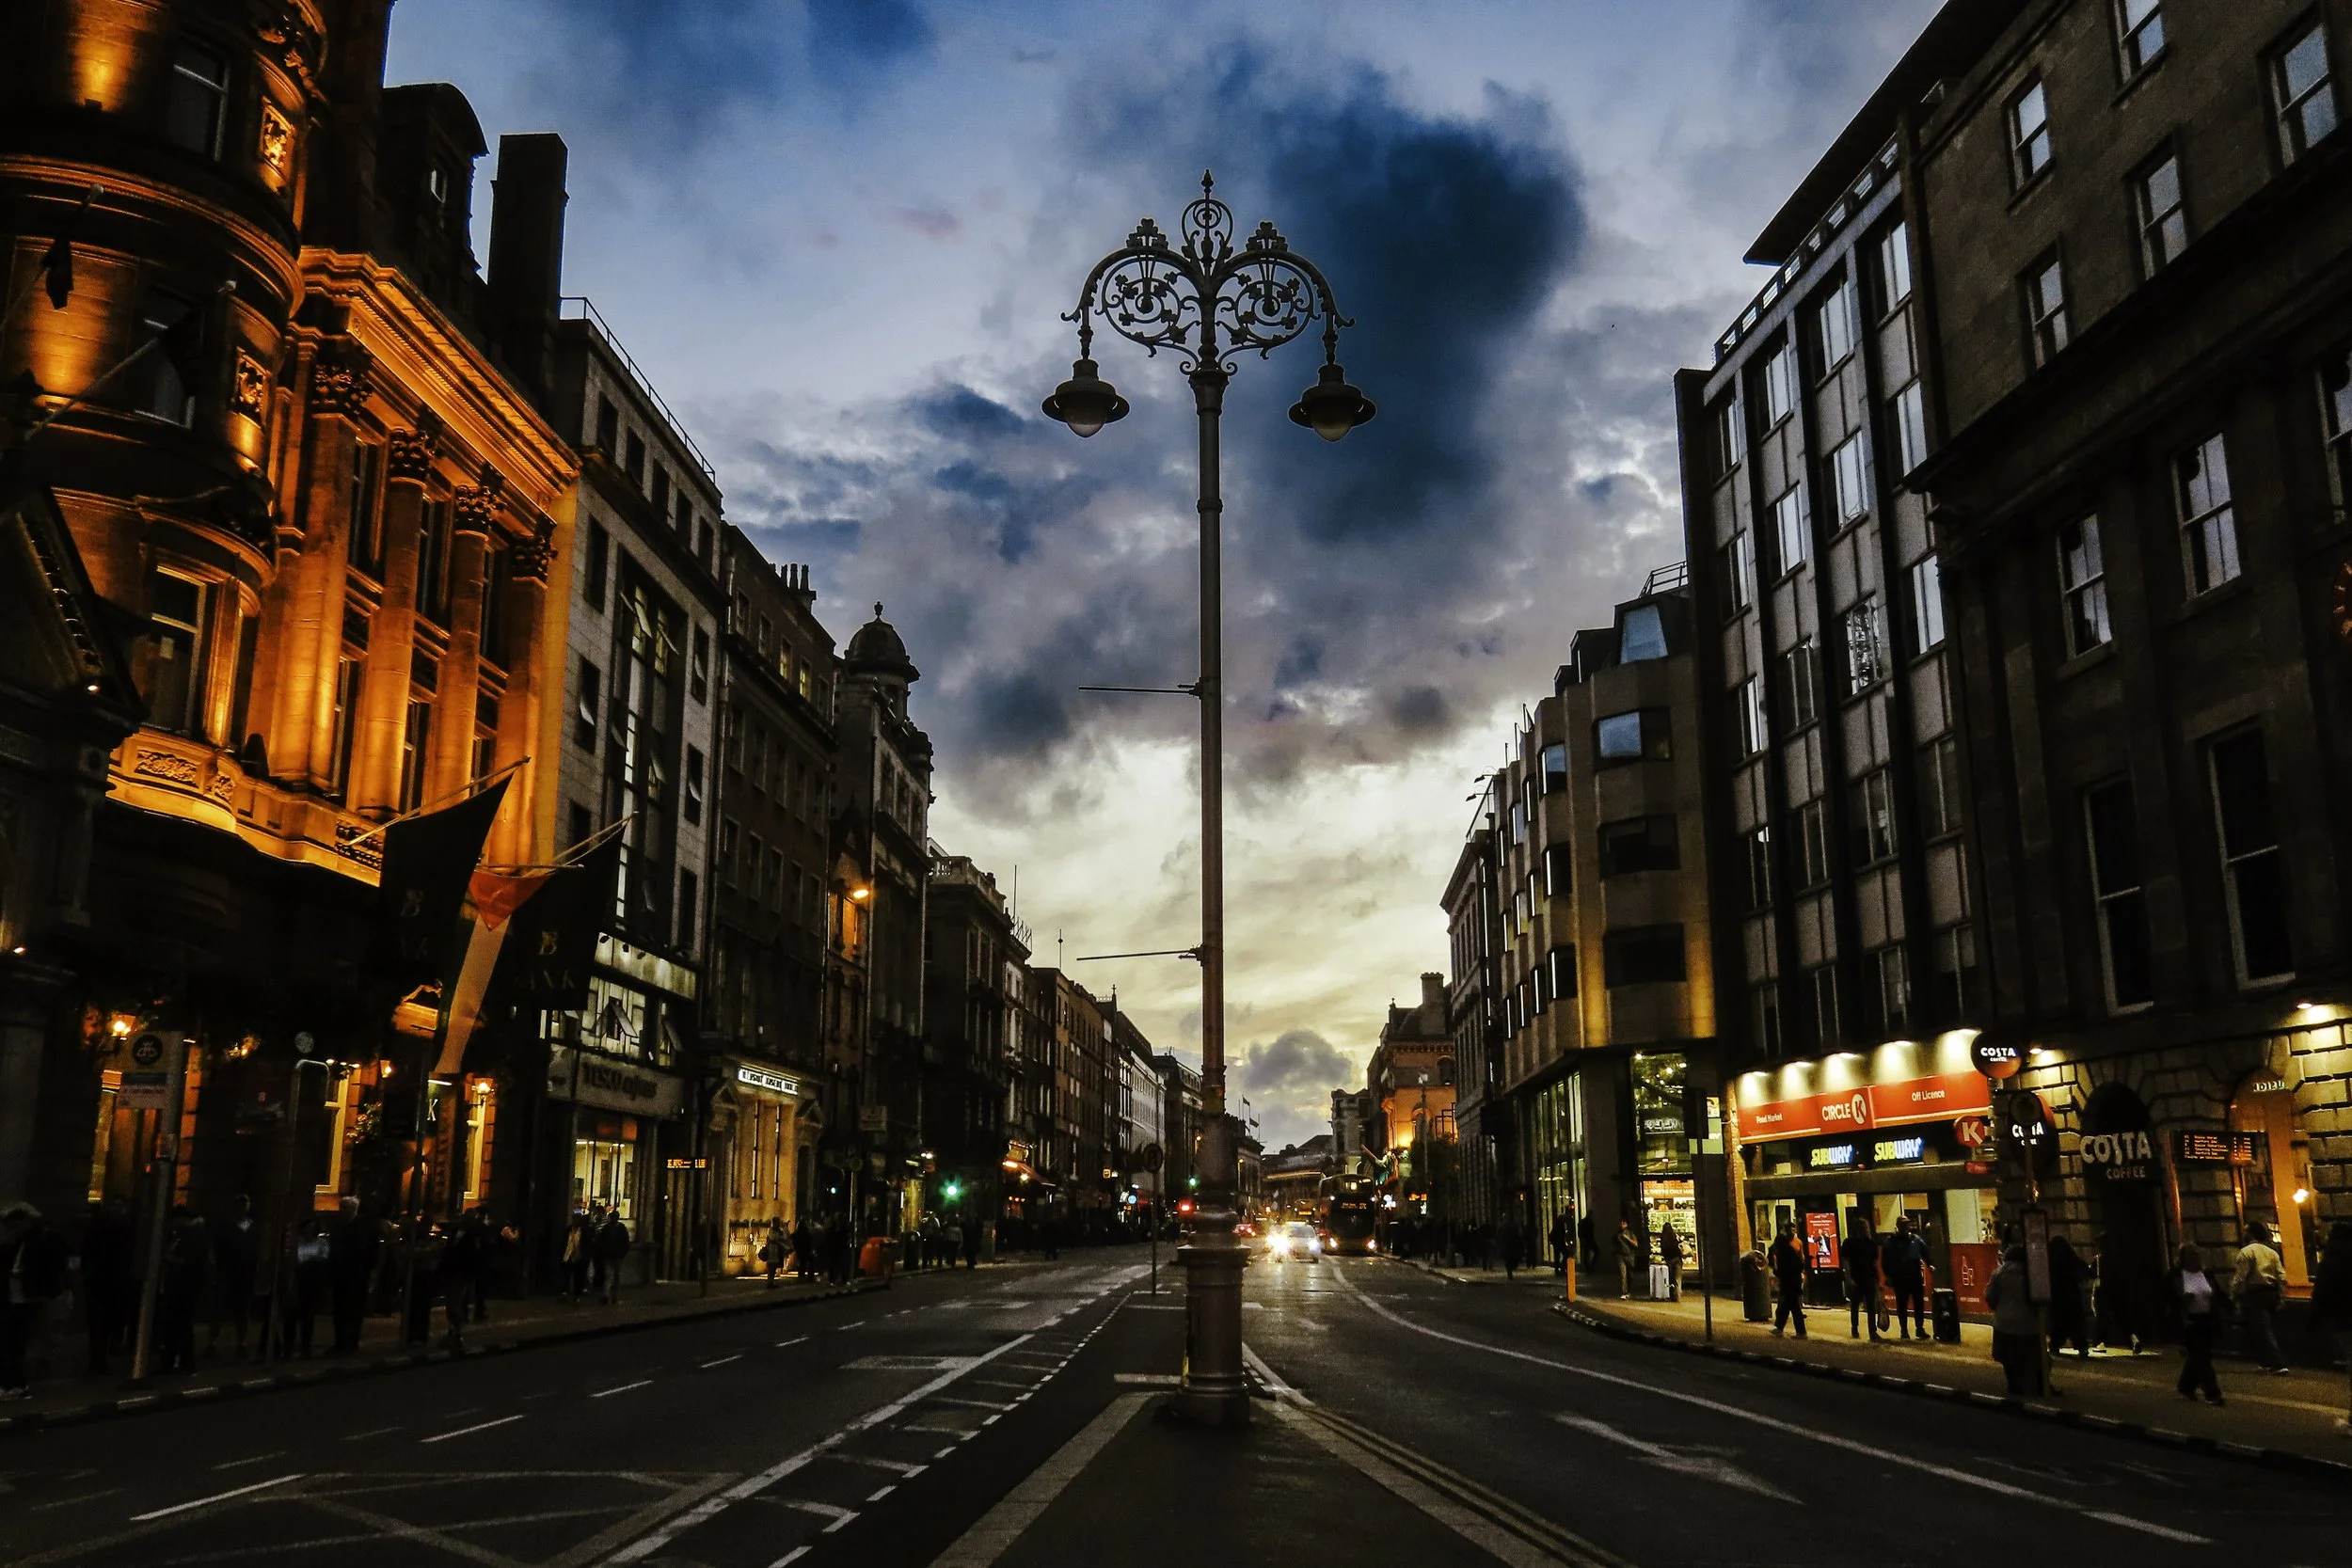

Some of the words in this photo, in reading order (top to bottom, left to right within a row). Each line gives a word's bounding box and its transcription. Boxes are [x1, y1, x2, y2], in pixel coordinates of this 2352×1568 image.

[1980, 1046, 2016, 1058] COSTA
[1912, 1091, 1921, 1101] Off
[1922, 1088, 1946, 1101] Licence
[1756, 1115, 1767, 1124] Food
[1767, 1112, 1783, 1123] Market
[1821, 1102, 1851, 1121] CIRCLE
[1852, 1096, 1866, 1122] K
[1962, 1121, 1983, 1145] K
[2011, 1122, 2044, 1138] COTA
[1811, 1144, 1852, 1167] SUBWAY
[1874, 1136, 1922, 1163] SUBWAY
[2080, 1131, 2152, 1165] COSTA
[2106, 1165, 2146, 1180] COFFEE
